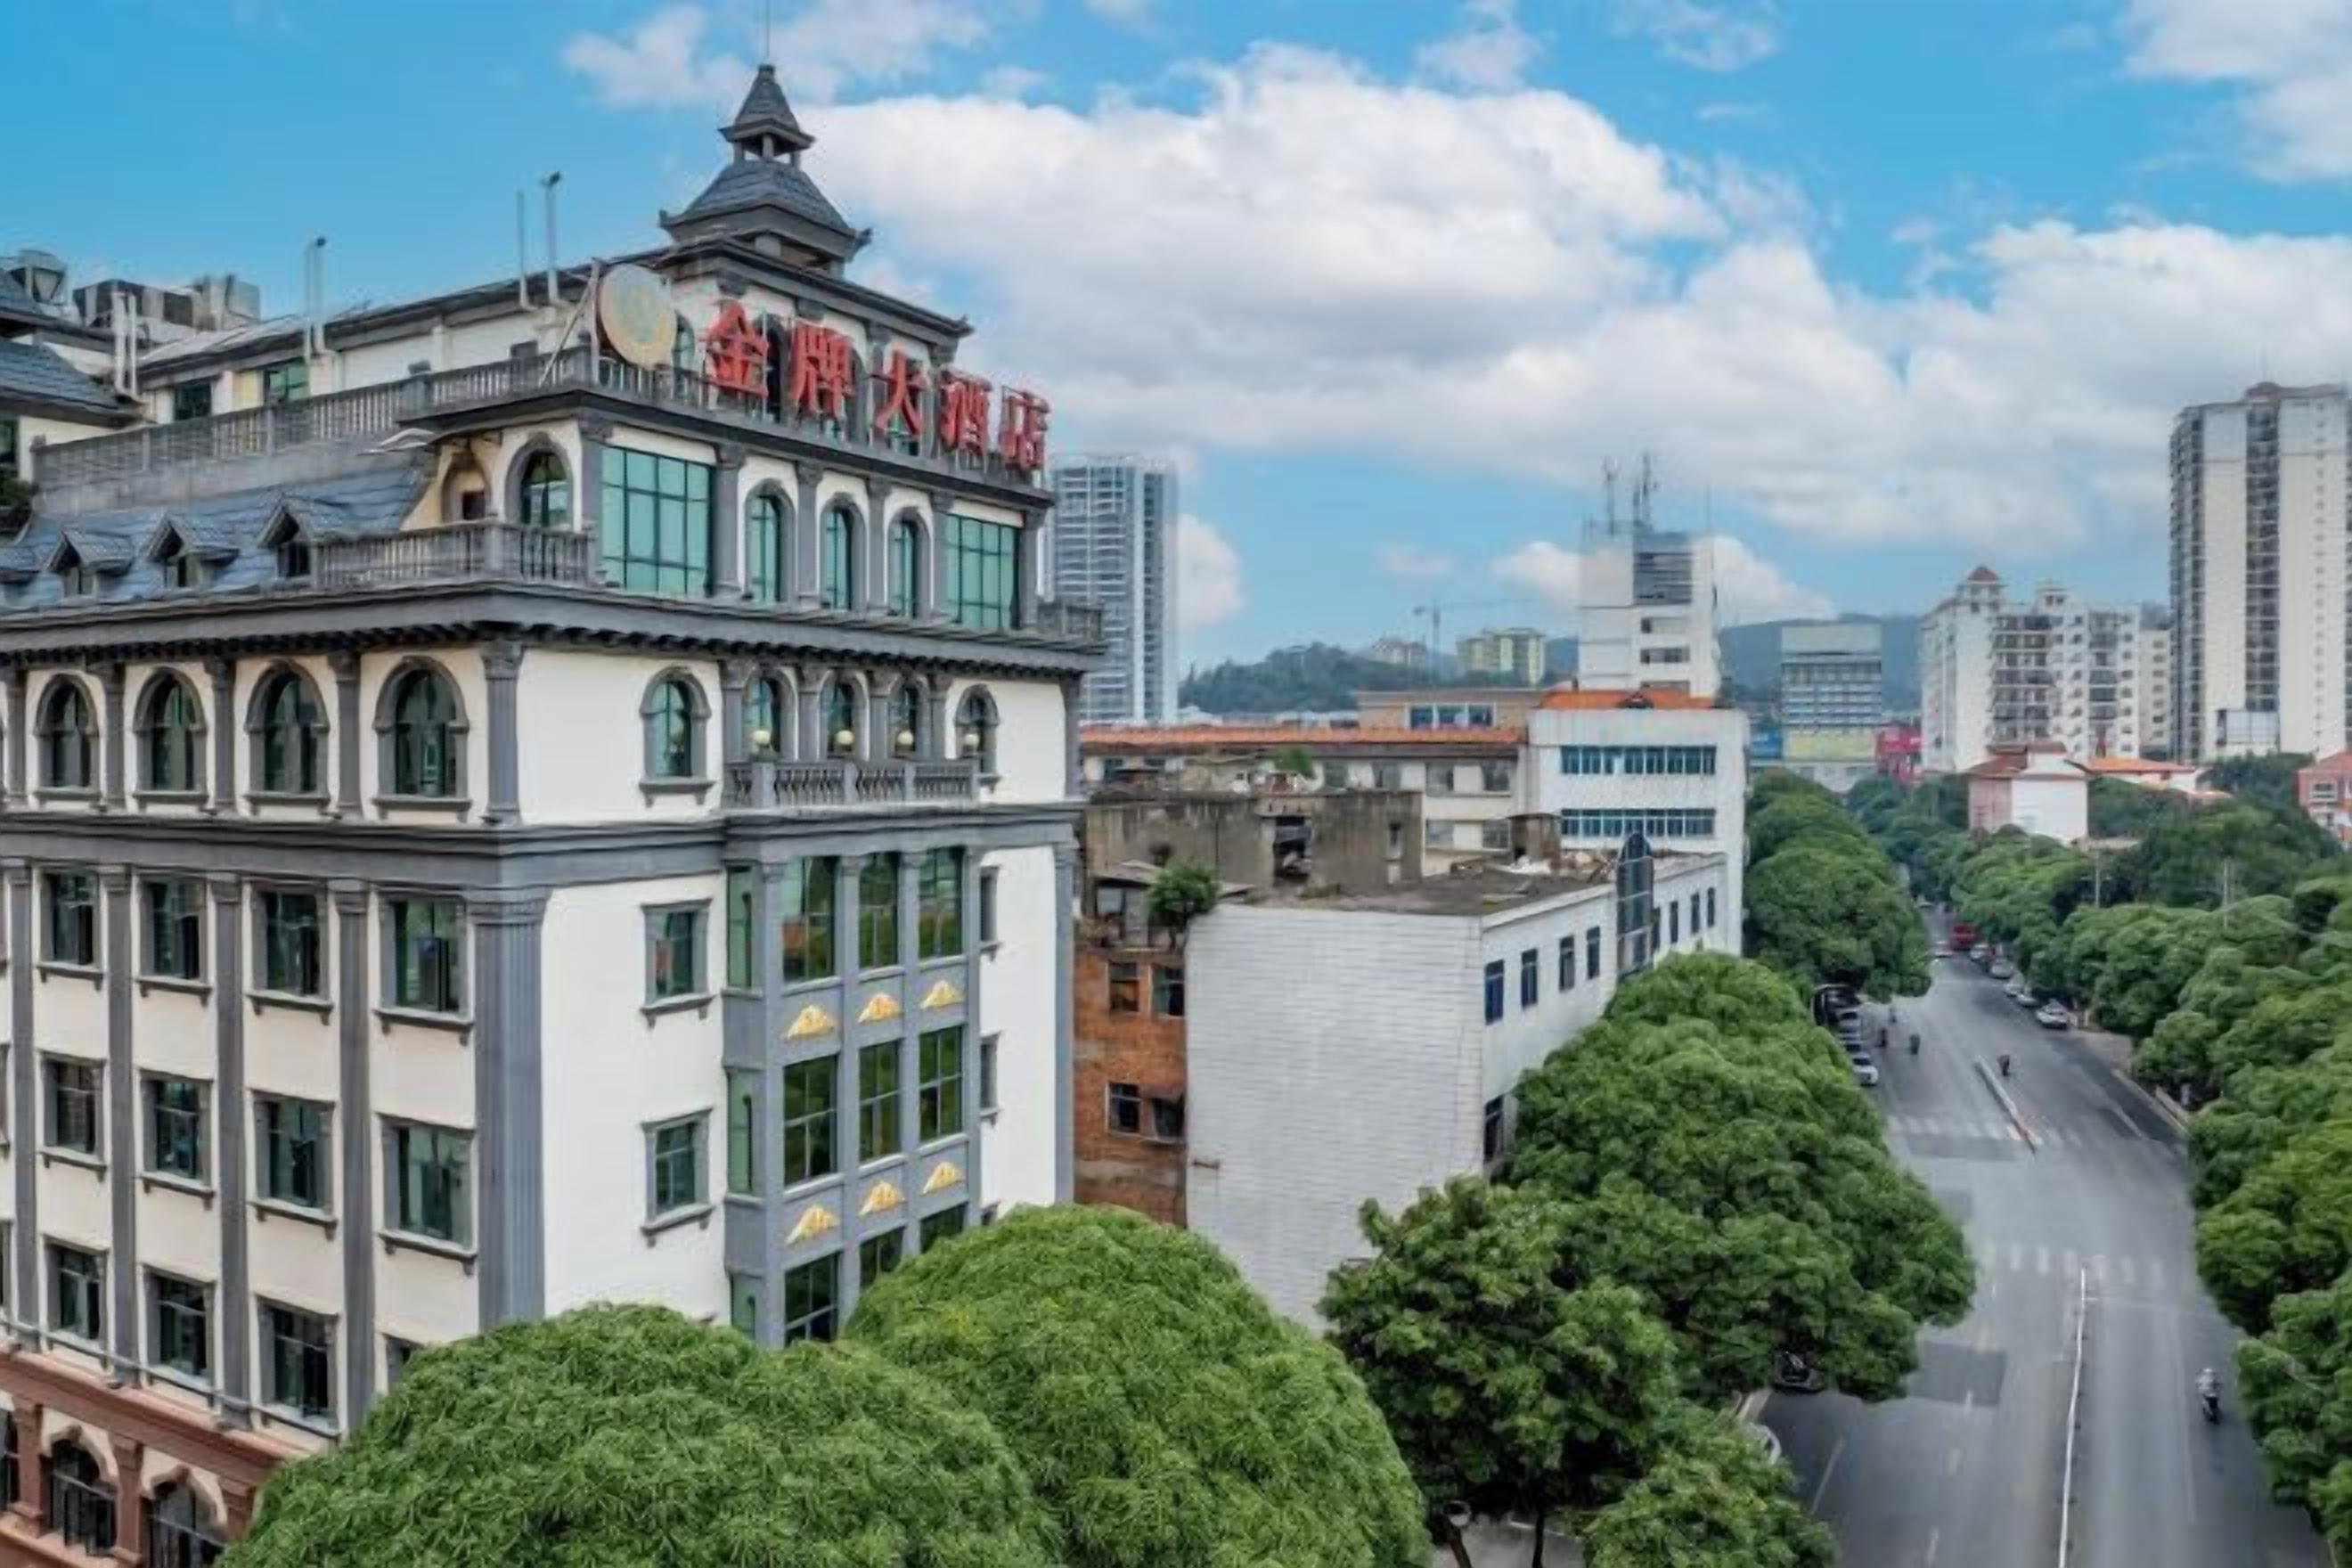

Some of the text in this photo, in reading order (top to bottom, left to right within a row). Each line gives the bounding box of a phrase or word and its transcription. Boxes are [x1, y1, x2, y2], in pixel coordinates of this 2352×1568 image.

[706, 299, 1050, 470] 金牌大酒店
